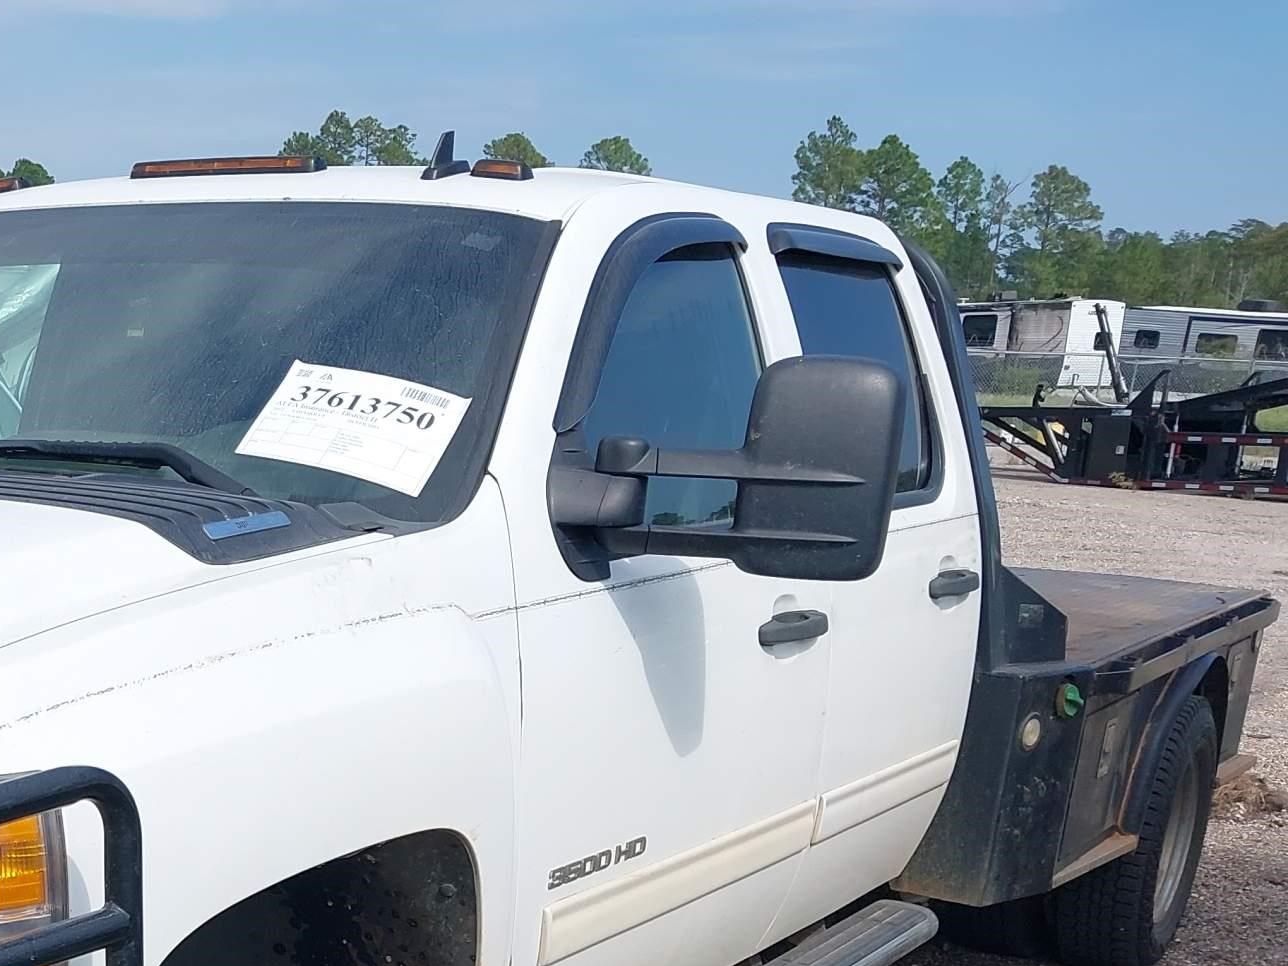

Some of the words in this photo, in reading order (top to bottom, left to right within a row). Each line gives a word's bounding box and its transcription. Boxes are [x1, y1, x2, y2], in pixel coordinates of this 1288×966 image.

[290, 386, 436, 430] 37613750
[548, 849, 612, 890] 3500
[614, 836, 647, 865] HD
